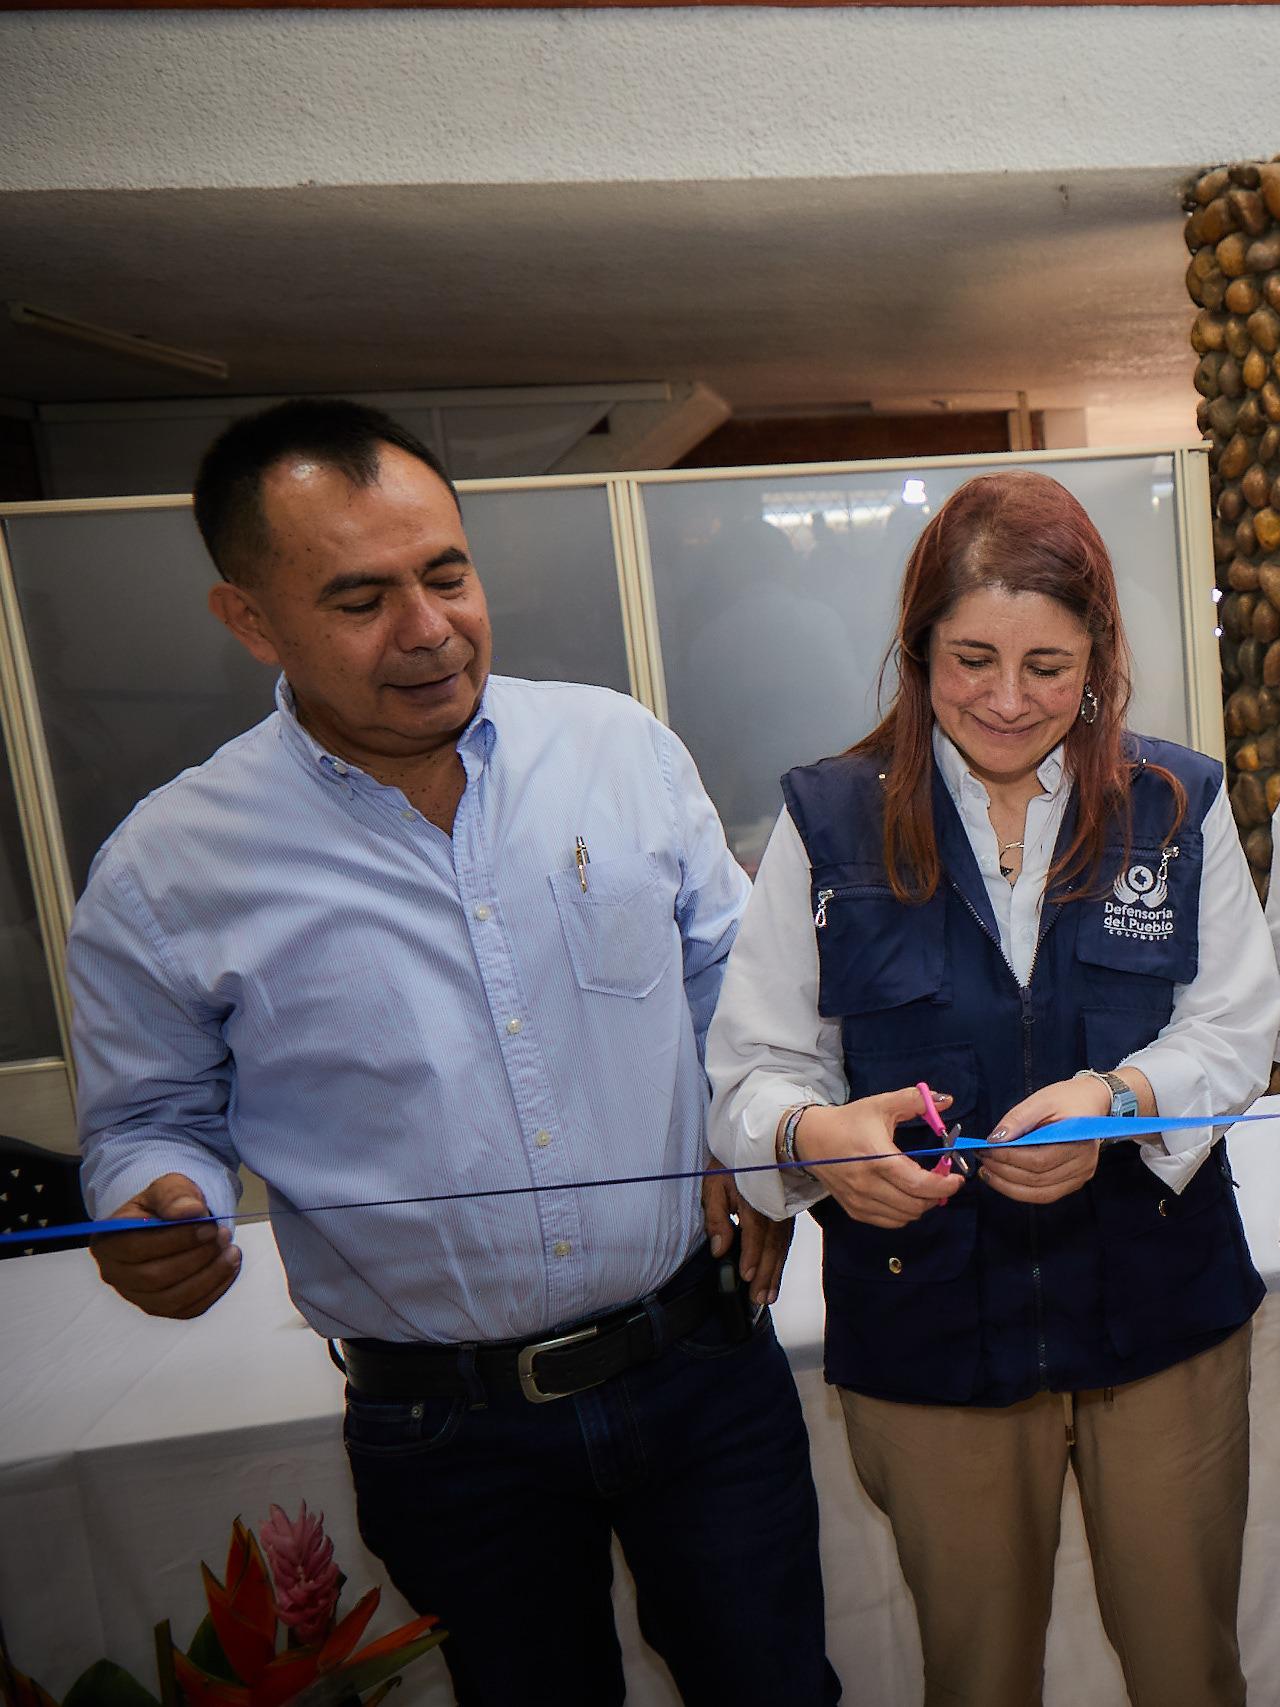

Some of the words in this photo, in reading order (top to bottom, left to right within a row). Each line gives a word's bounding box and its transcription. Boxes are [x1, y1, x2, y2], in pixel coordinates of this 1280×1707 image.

[1104, 915, 1126, 927] del
[1129, 918, 1173, 932] Pueblo
[1109, 929, 1168, 941] COLOMBIA
